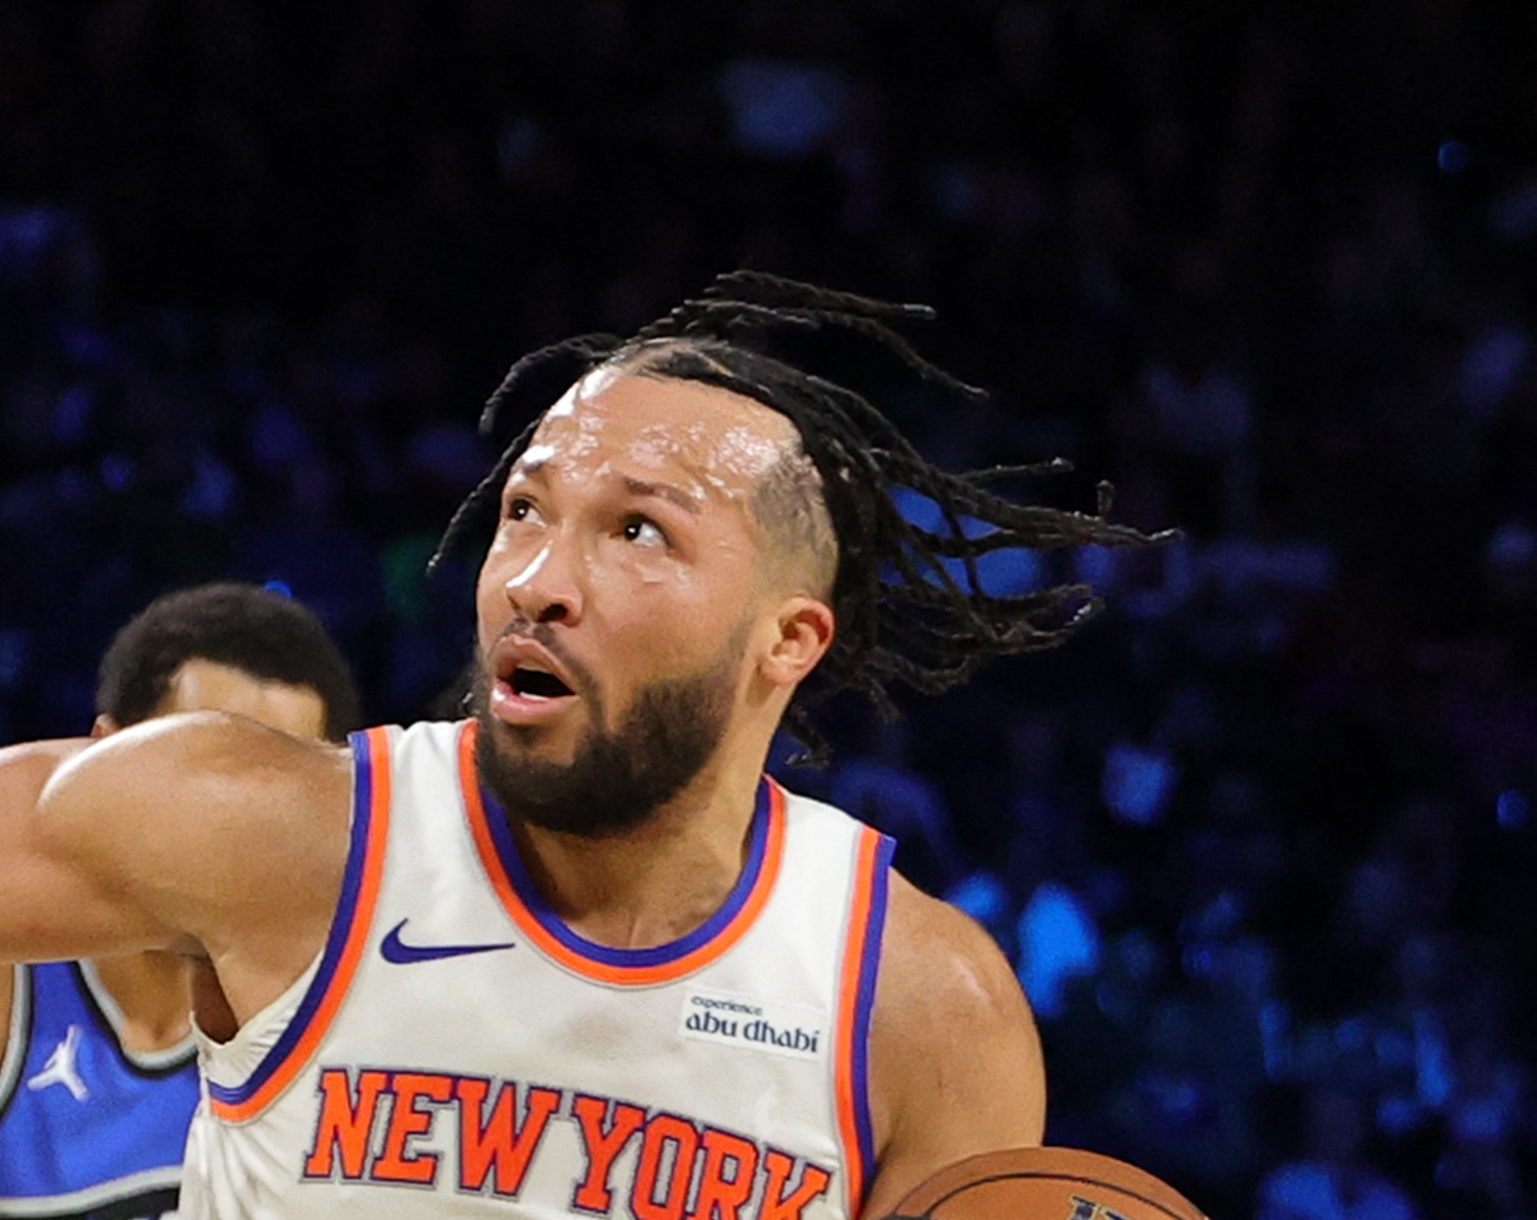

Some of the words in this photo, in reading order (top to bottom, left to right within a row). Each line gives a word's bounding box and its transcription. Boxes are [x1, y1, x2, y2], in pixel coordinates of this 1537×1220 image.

[690, 995, 763, 1016] experience
[685, 1011, 738, 1038] abu
[743, 1019, 821, 1053] dhabi
[302, 1067, 561, 1198] NEW
